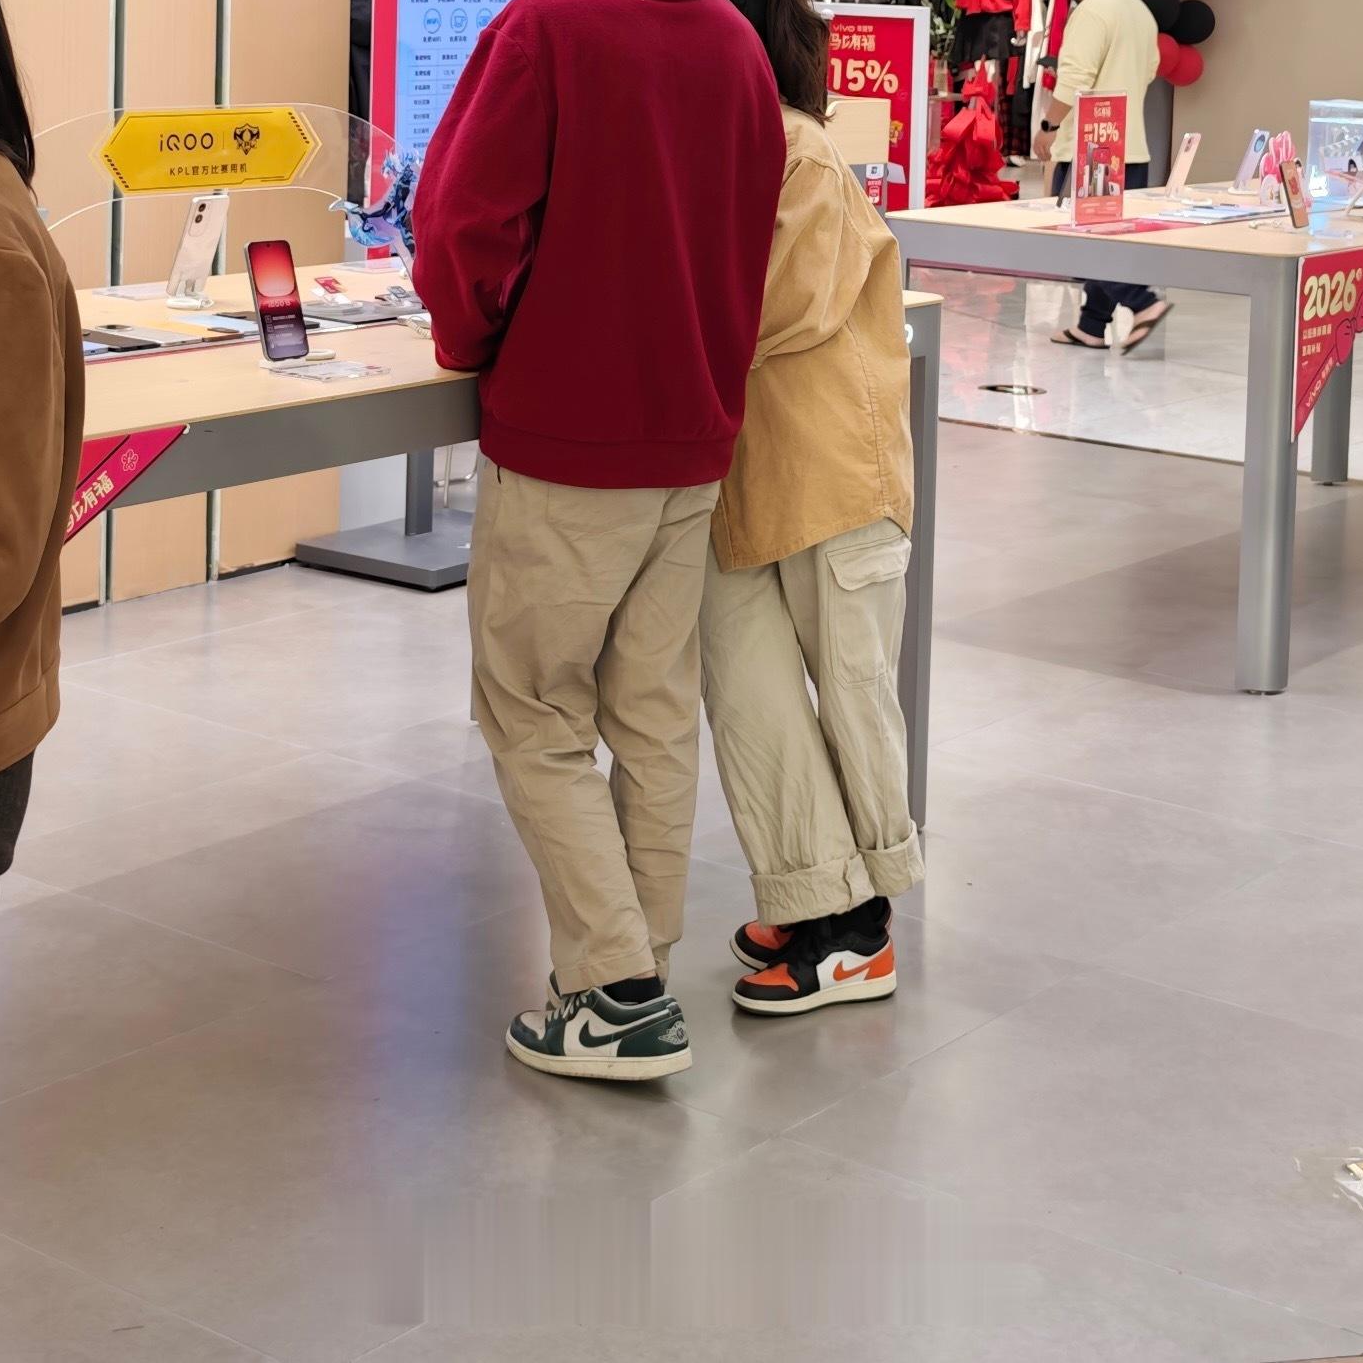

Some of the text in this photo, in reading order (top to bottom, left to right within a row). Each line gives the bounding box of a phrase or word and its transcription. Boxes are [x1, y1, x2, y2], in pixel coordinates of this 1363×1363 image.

[830, 57, 899, 94] 15%
[159, 133, 214, 152] iQOO
[1303, 270, 1357, 321] 2026
